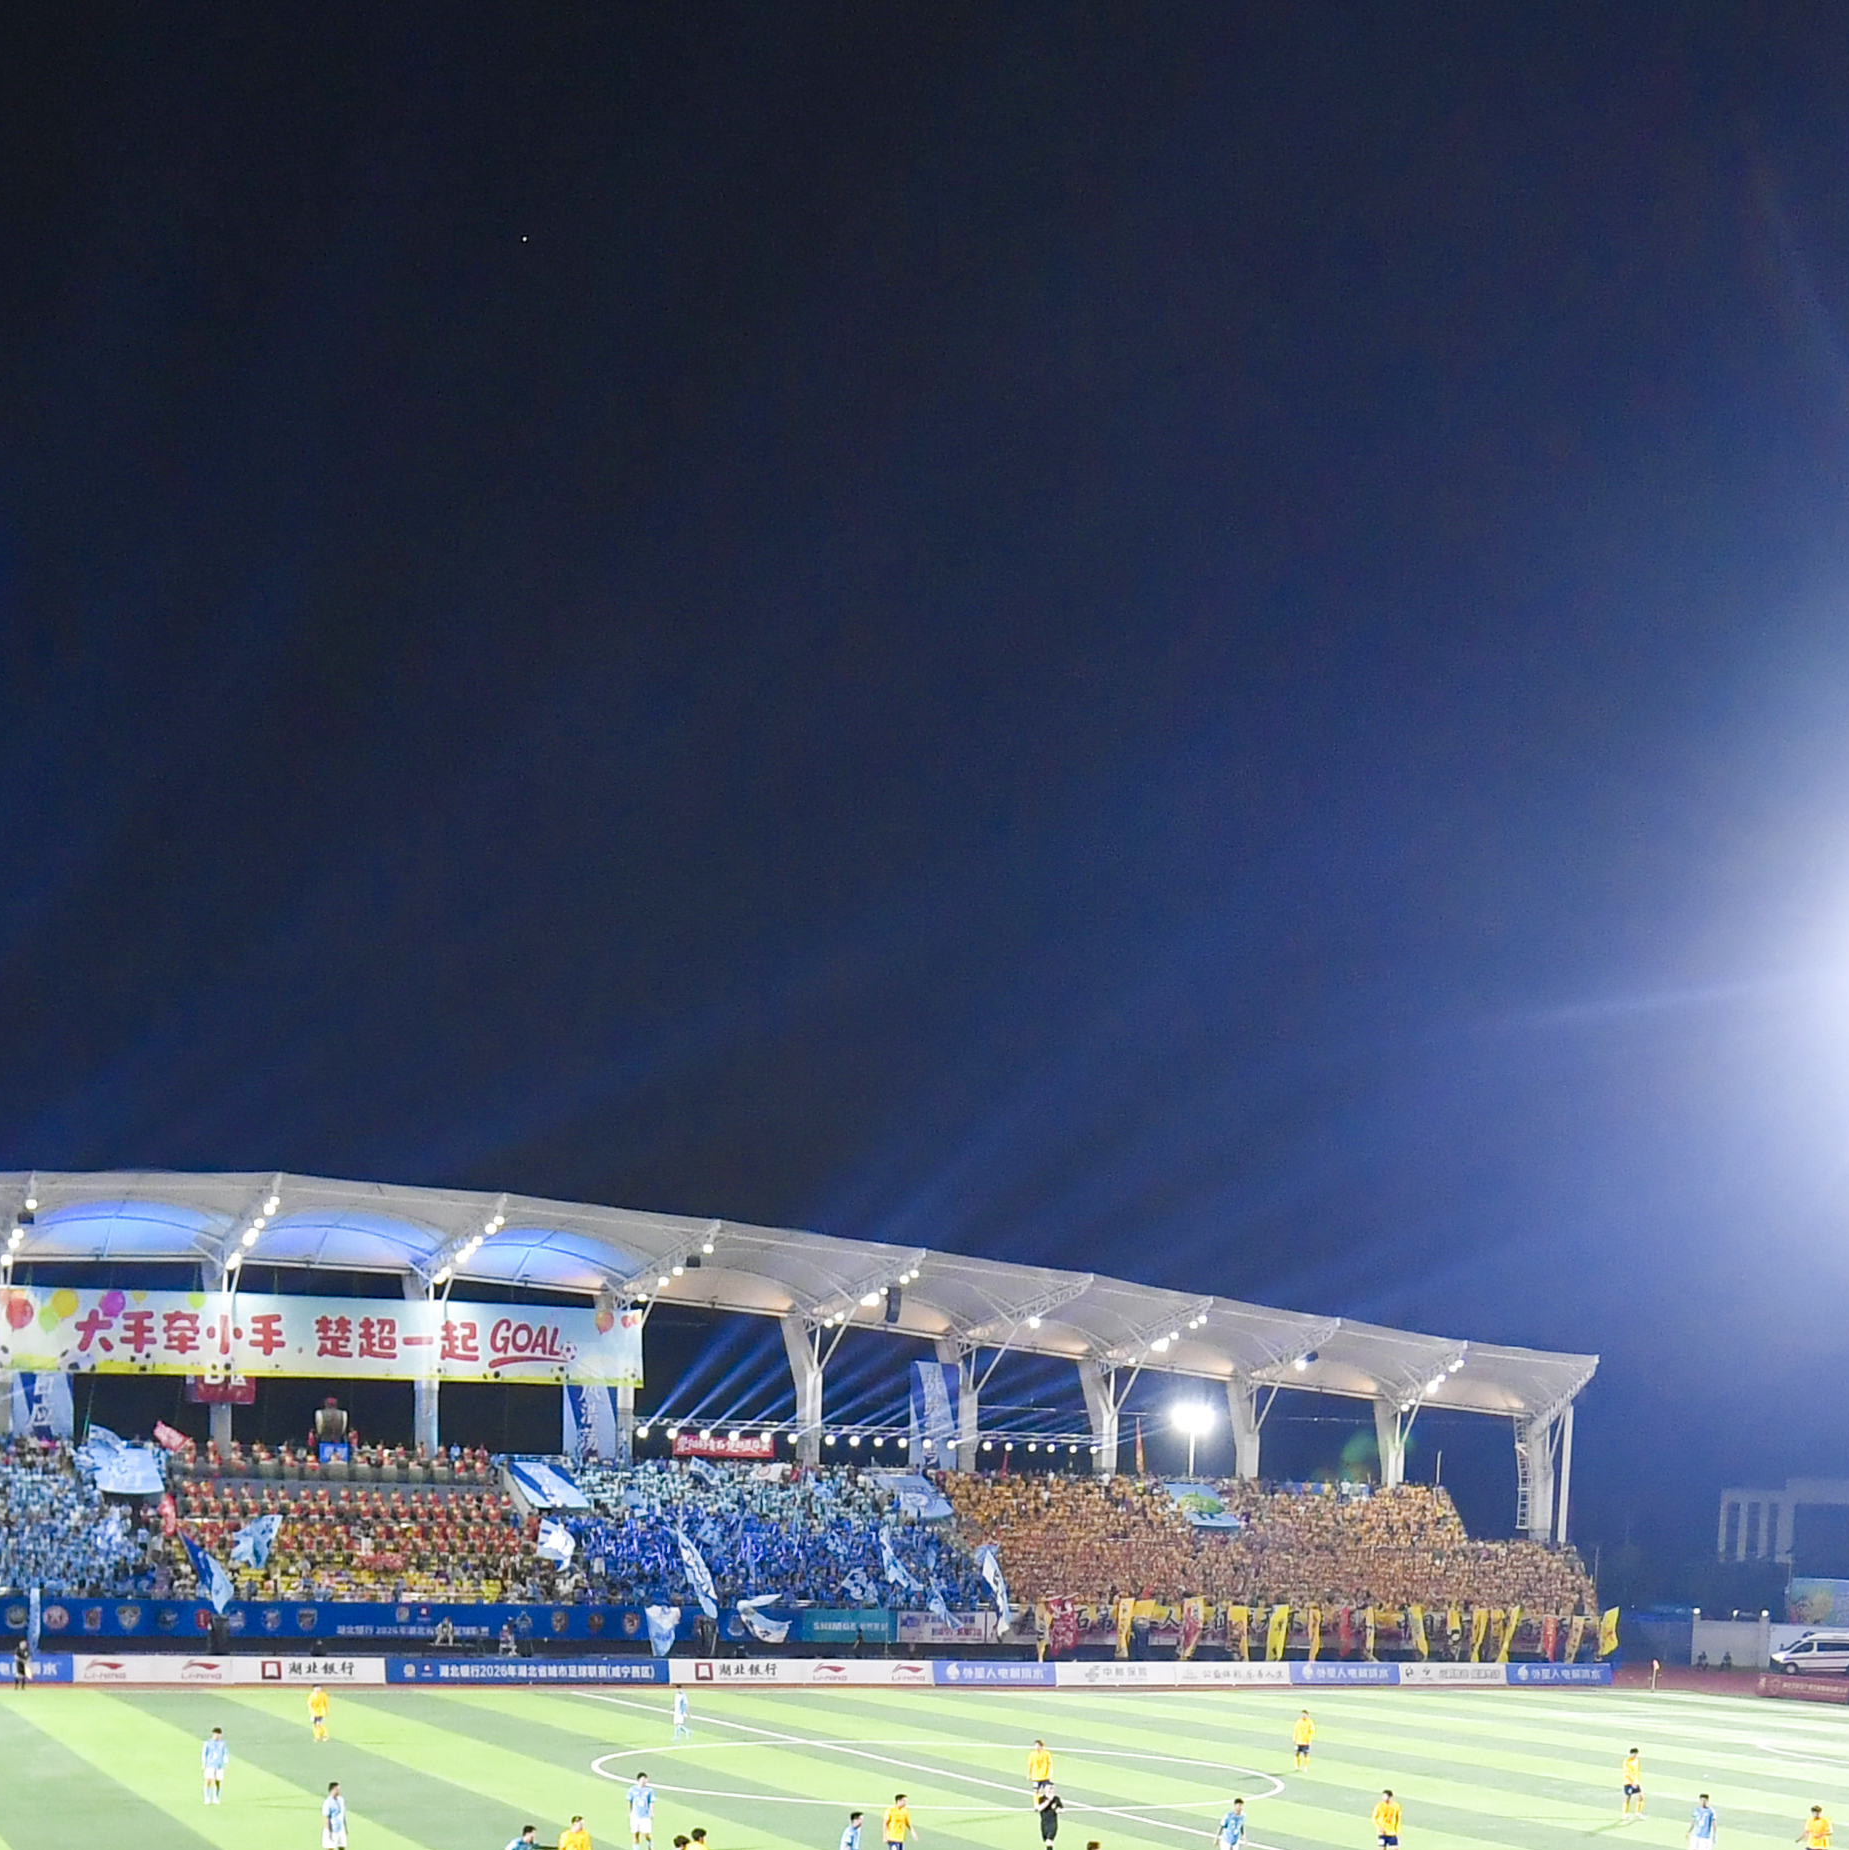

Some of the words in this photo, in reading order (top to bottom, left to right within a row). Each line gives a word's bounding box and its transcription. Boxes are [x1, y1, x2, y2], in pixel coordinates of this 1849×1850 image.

[74, 1308, 286, 1355] 大手牵小手
[314, 1315, 479, 1362] 楚超一起
[490, 1319, 562, 1361] GOAL
[288, 1661, 356, 1677] 湖北银行
[718, 1662, 778, 1676] 湖北银行
